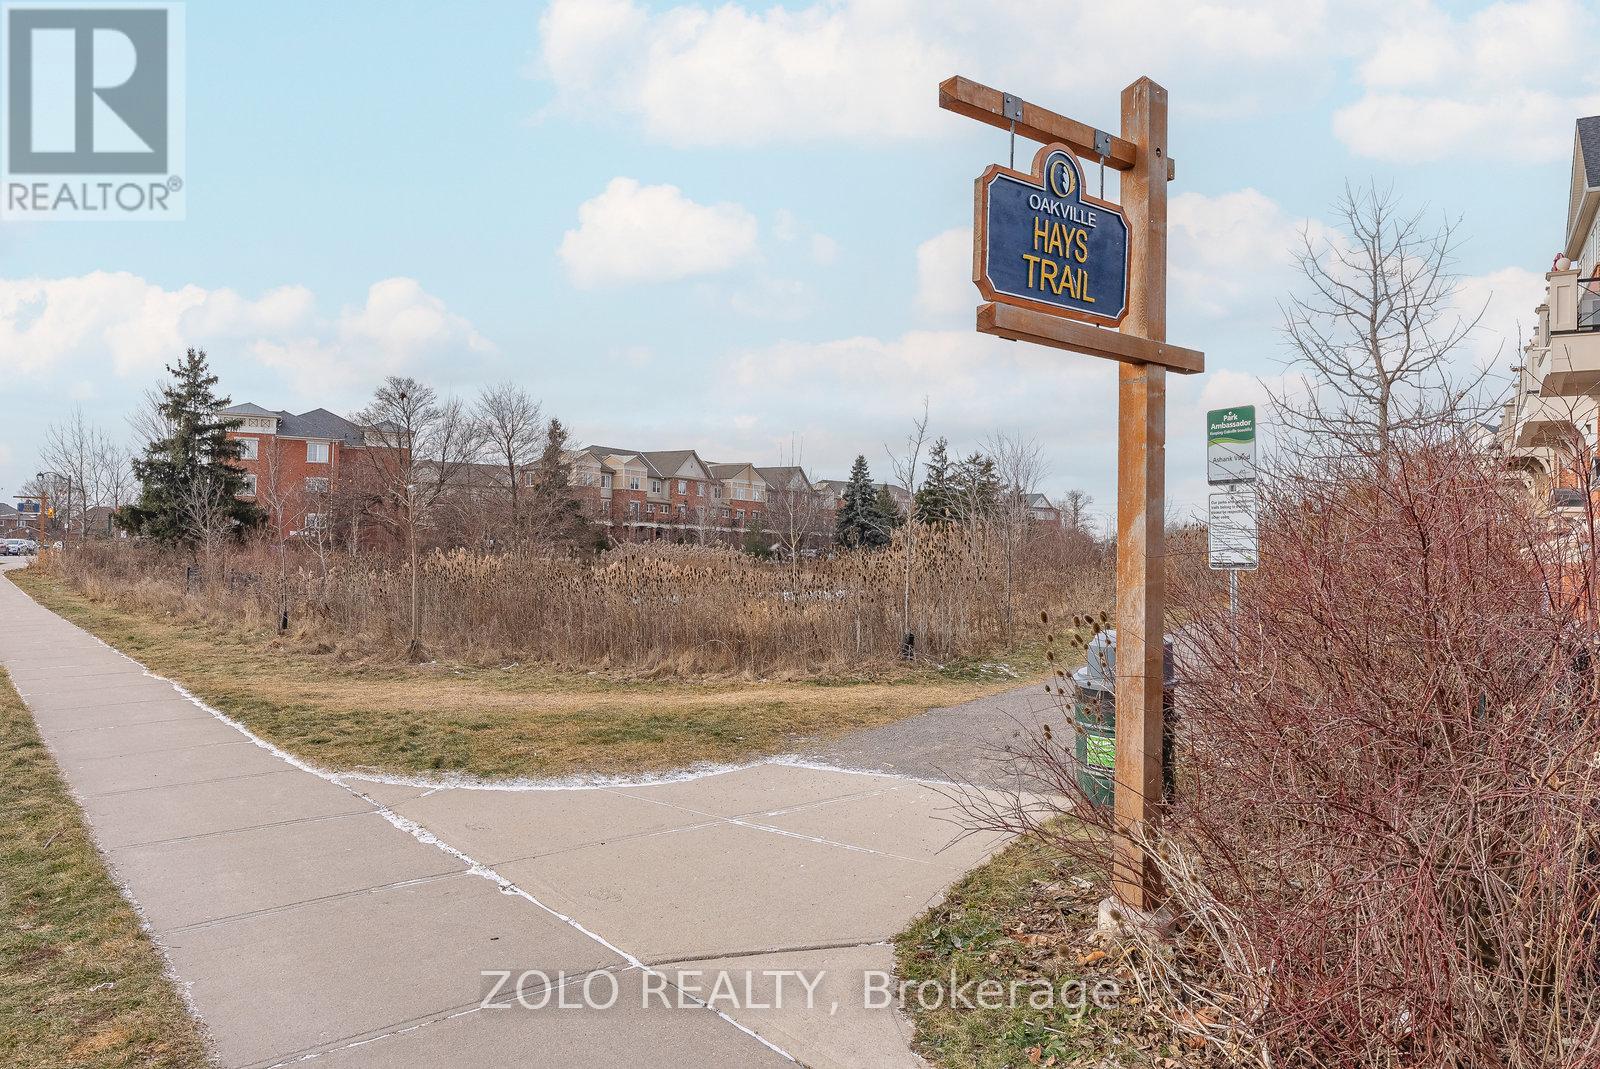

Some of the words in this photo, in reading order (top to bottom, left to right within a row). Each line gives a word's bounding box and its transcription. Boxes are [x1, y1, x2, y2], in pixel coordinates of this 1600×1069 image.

[1029, 194, 1097, 228] OAKVILLE
[1033, 216, 1088, 264] HAYS
[1022, 253, 1096, 303] TRAIL
[1210, 420, 1251, 430] Ambassador
[1223, 414, 1238, 422] Park
